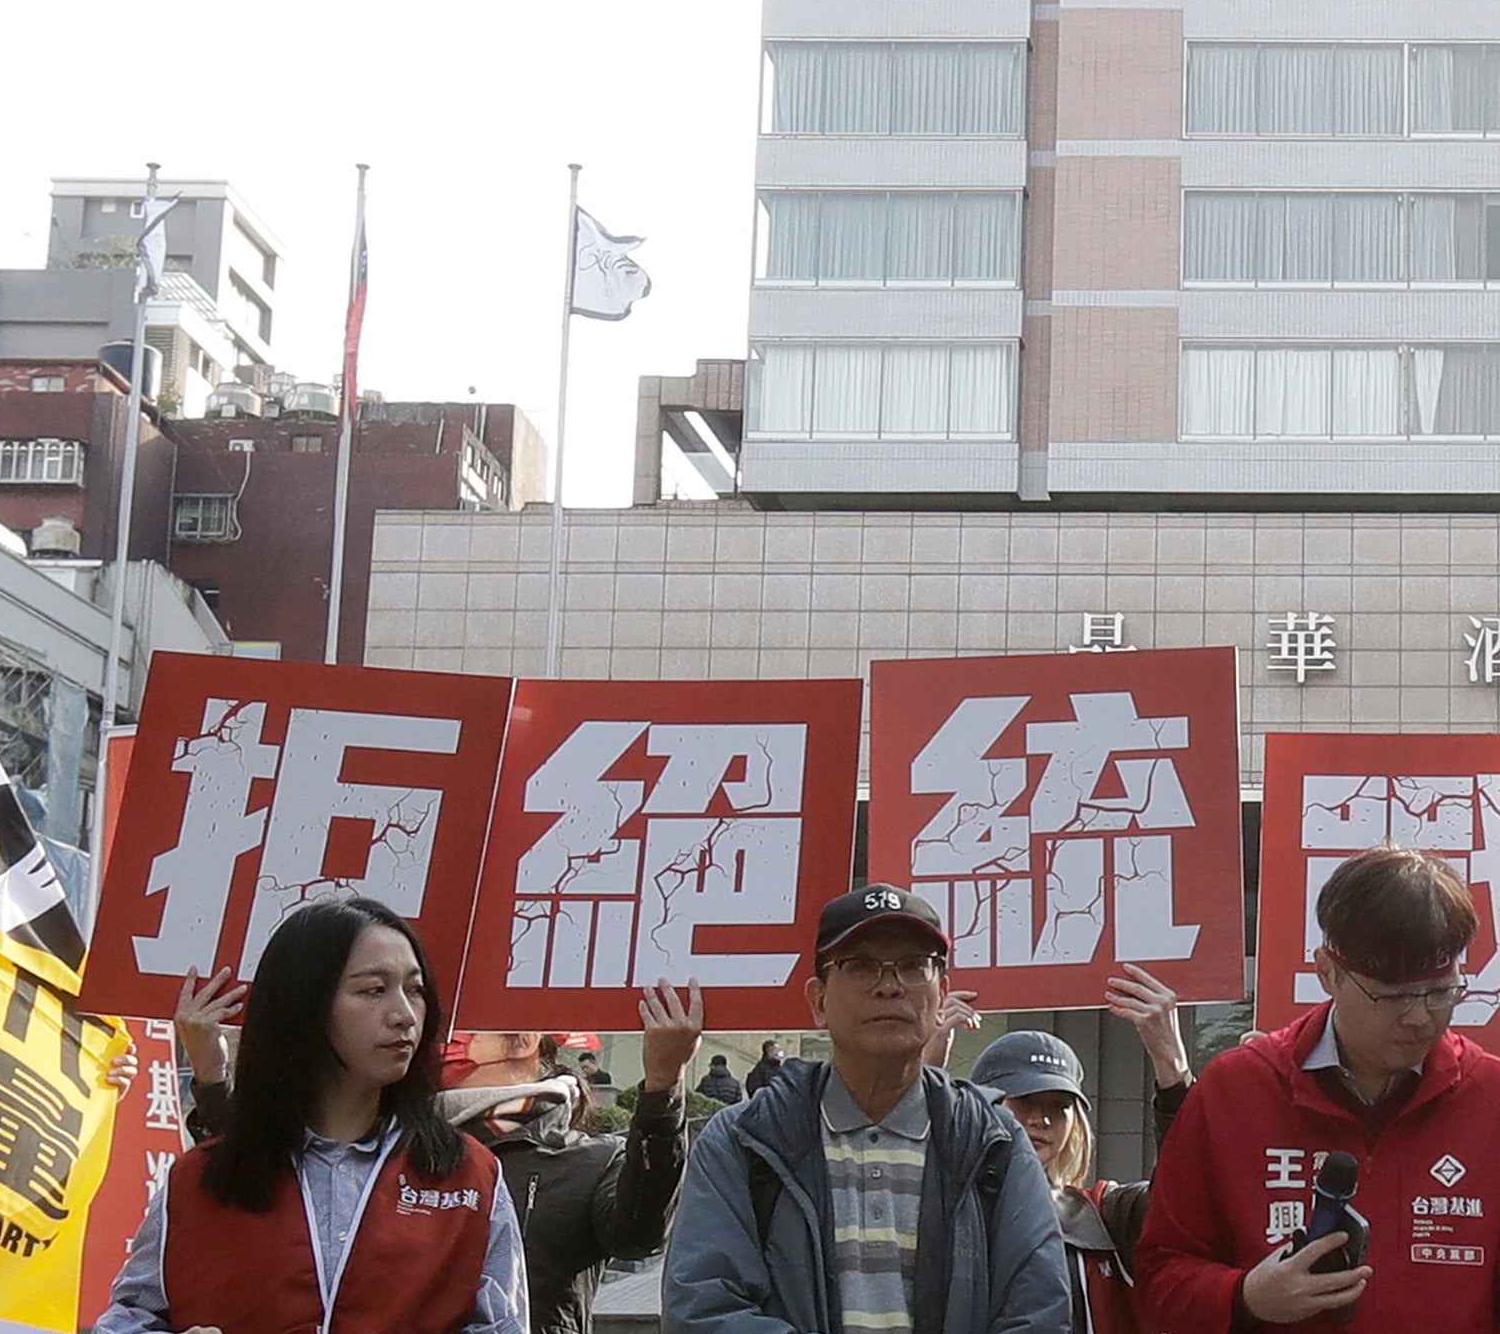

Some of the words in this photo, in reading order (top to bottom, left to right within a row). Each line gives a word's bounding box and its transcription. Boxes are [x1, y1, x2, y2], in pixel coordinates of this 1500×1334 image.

[400, 1185, 480, 1212] 台灣基進
[1411, 1196, 1484, 1217] 台灣基進
